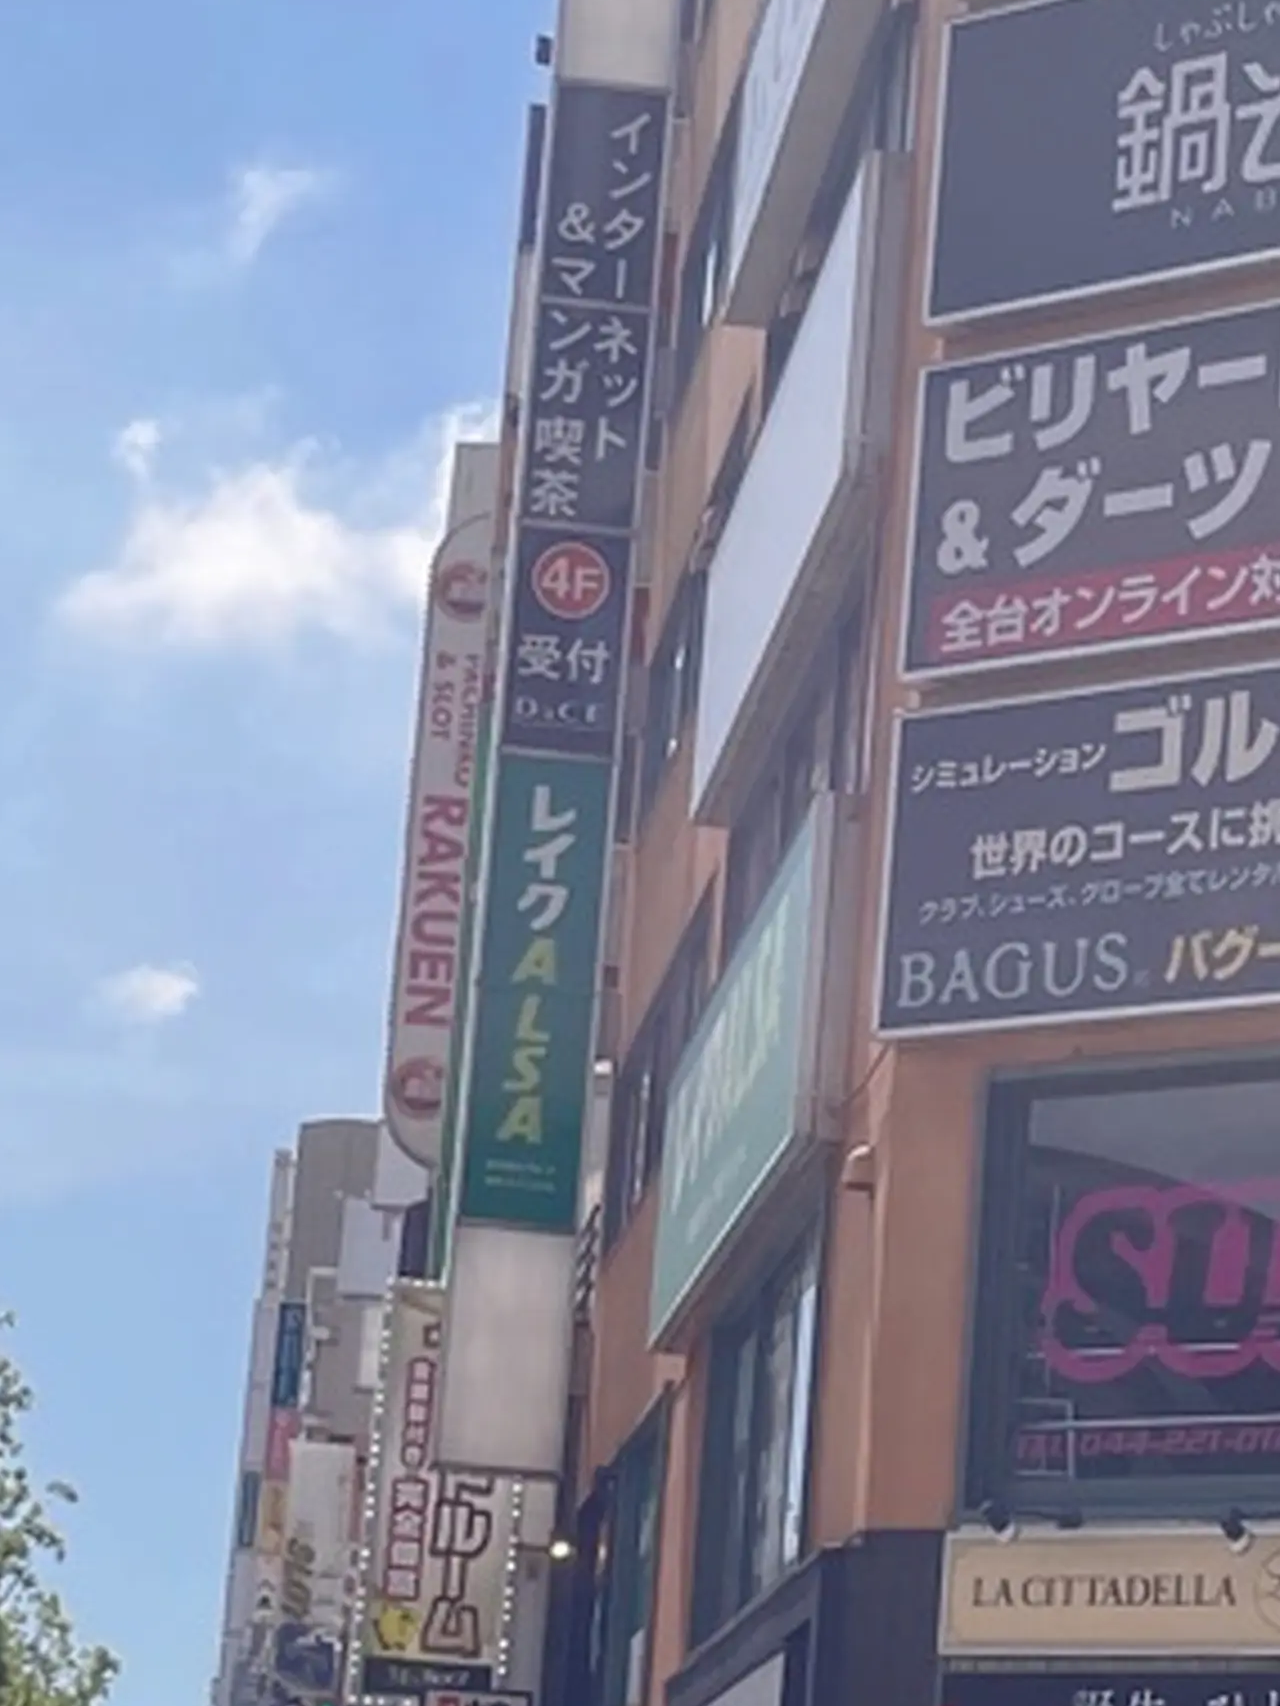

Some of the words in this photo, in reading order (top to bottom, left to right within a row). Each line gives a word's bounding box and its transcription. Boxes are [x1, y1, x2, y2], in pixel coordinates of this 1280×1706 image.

[594, 112, 653, 462] インターネット
[530, 200, 597, 519] &マンガ喫茶
[541, 557, 602, 602] 4F
[518, 634, 611, 684] 受付
[403, 794, 469, 1030] RAKUEN
[896, 933, 1130, 1009] BAGUS
[969, 1577, 1017, 1608] LA
[1021, 1576, 1236, 1609] CITTADELLA
